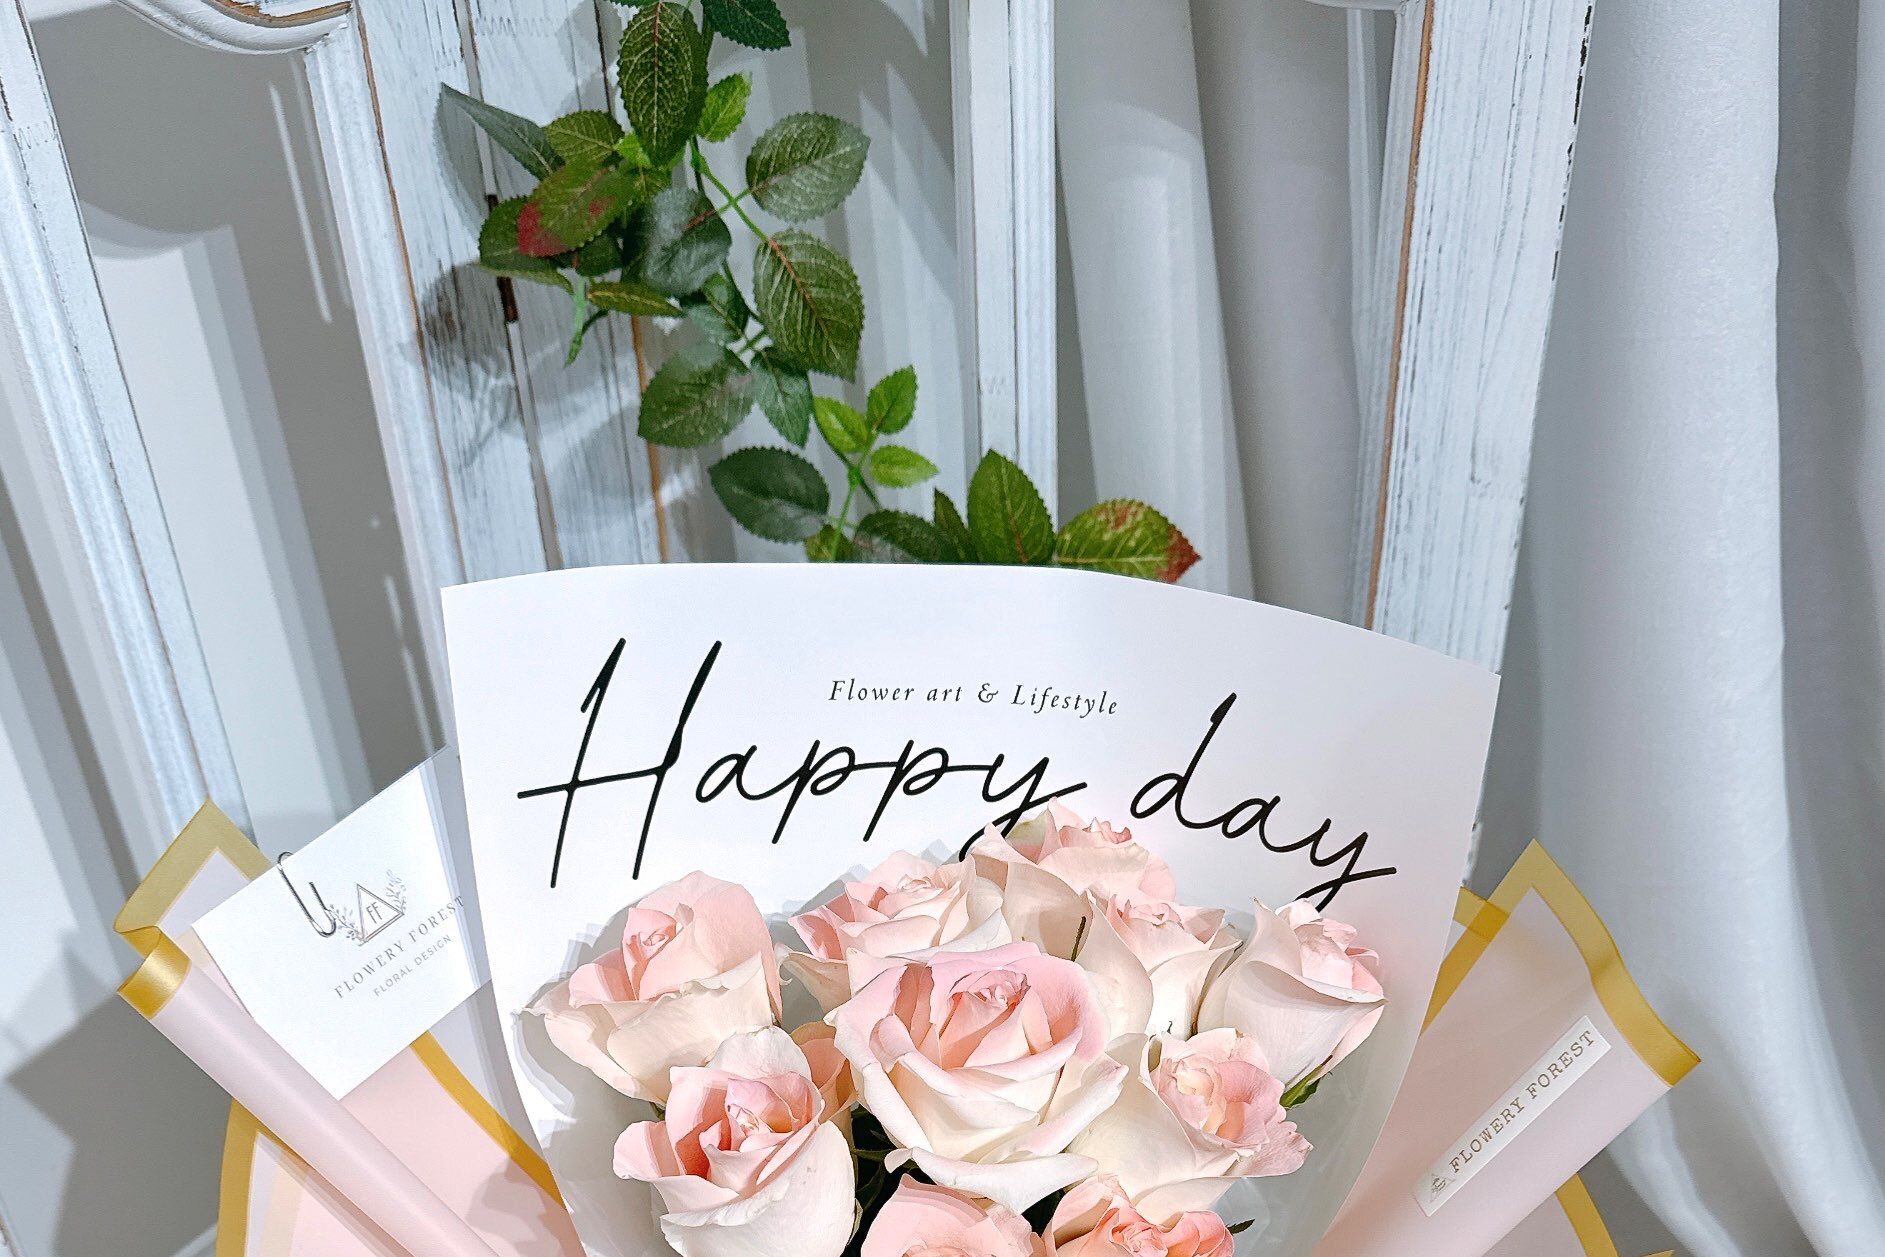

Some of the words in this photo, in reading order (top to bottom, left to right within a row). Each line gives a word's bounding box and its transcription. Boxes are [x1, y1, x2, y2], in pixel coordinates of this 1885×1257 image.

[828, 677, 915, 702] Flower
[926, 685, 963, 702] art
[977, 682, 999, 703] &
[1010, 684, 1118, 719] Lifestyle
[517, 637, 1088, 890] Happy
[1129, 692, 1397, 913] day
[333, 939, 405, 999] FLOWERY
[408, 895, 465, 943] FOREST
[373, 964, 413, 997] FLORAL
[413, 934, 452, 966] DESIGN
[1448, 1096, 1525, 1174] FLOWERY
[1525, 1030, 1595, 1100] FOREST
